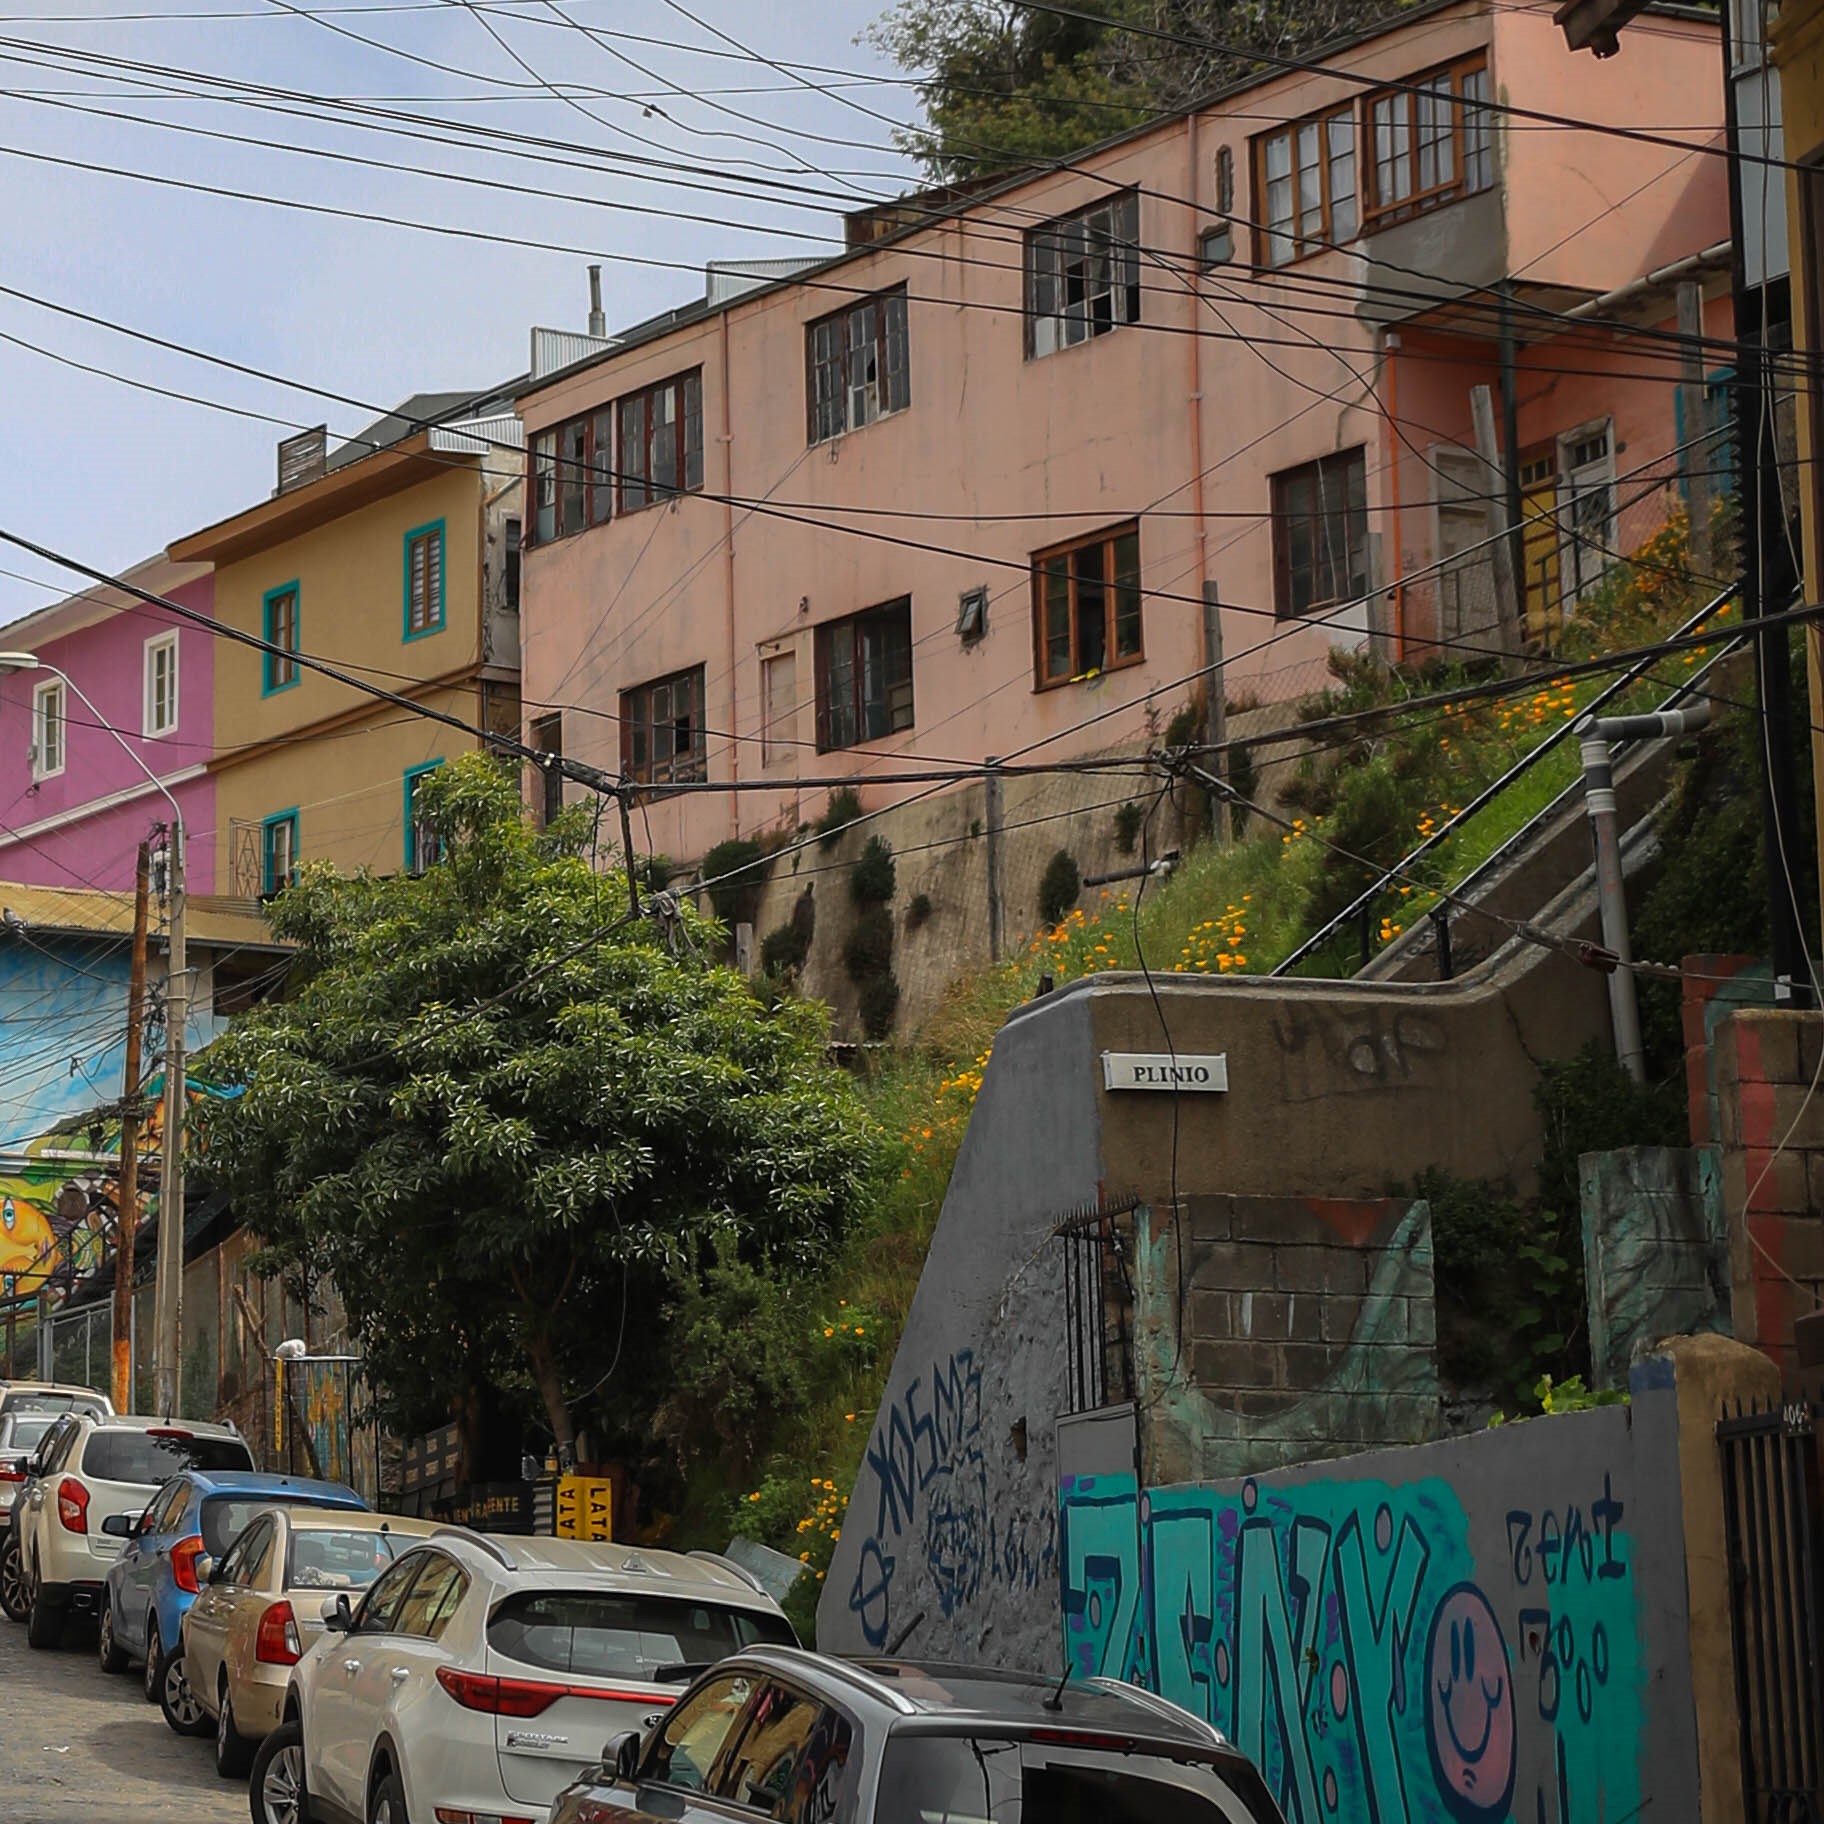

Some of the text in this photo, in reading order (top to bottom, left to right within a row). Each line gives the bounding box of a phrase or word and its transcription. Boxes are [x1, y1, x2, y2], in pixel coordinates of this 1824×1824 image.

[1133, 1066, 1210, 1083] PLINIO
[560, 1487, 576, 1540] ATA
[590, 1487, 608, 1542] LATA
